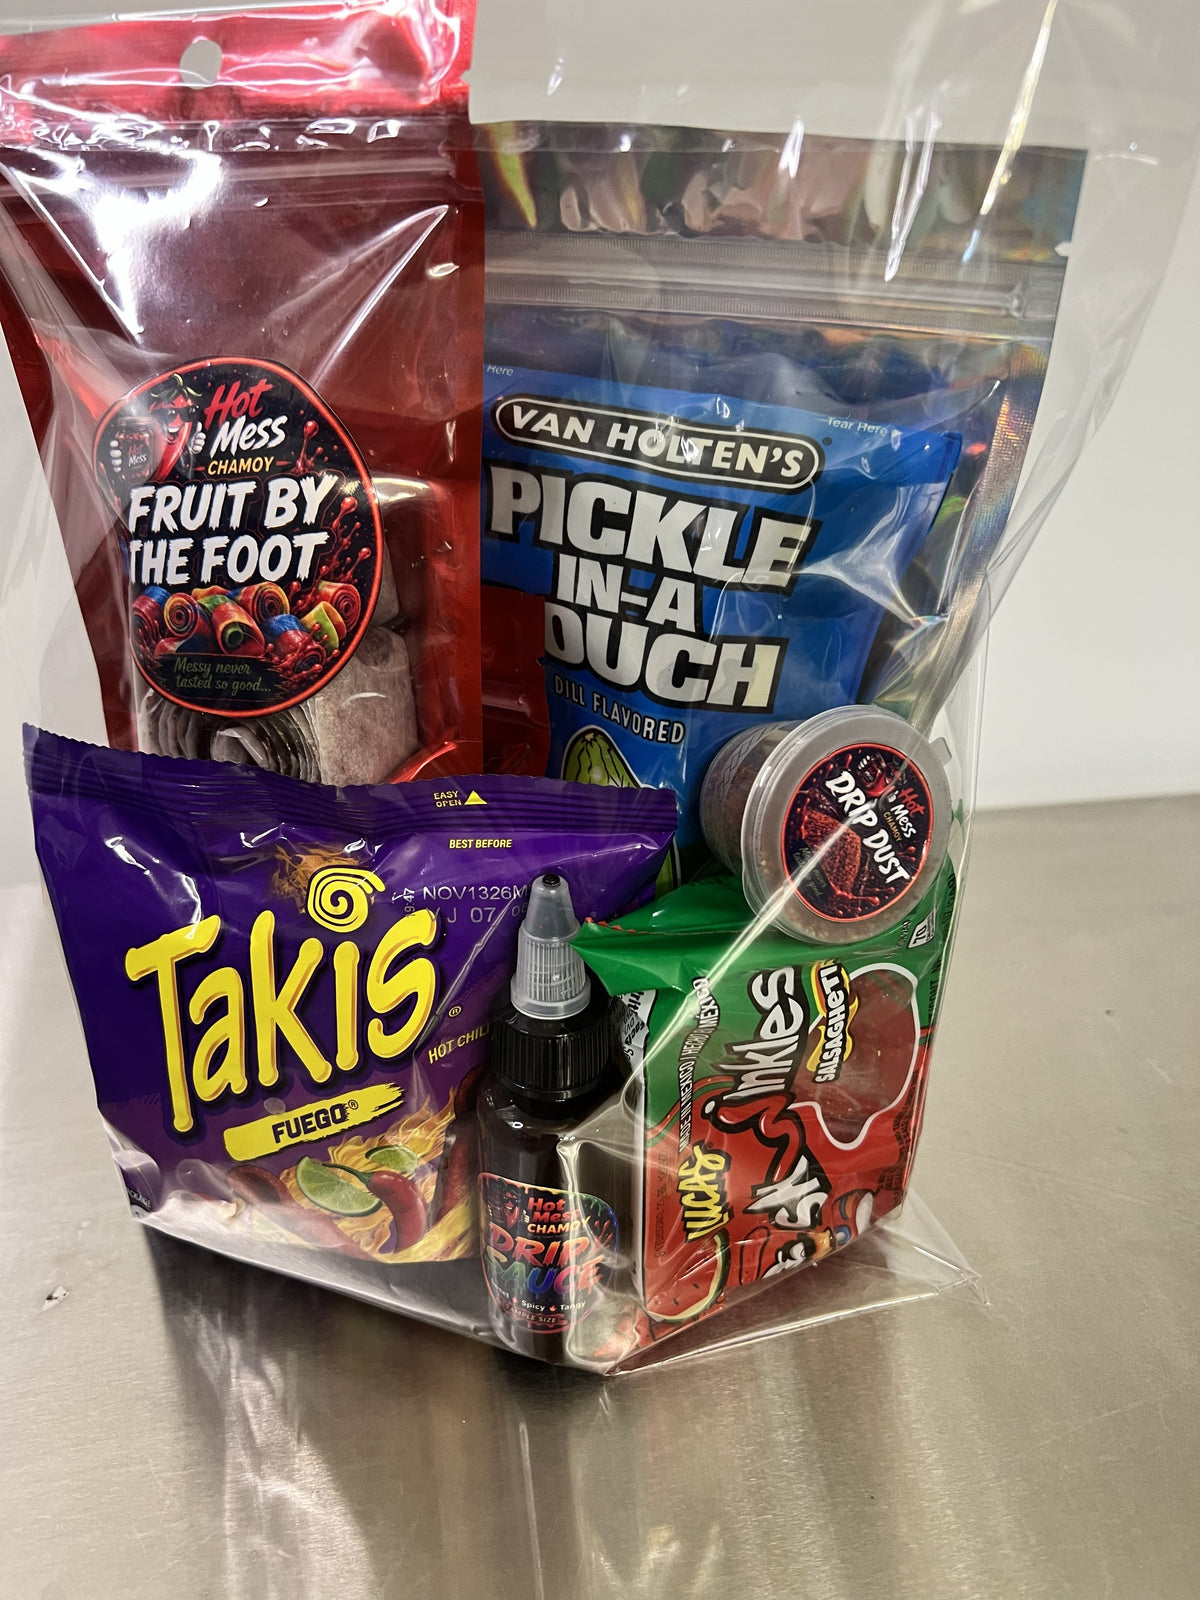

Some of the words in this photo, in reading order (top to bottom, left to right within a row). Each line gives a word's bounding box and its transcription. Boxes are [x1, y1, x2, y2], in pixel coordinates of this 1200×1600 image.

[486, 364, 514, 376] Here
[204, 379, 274, 431] Hot
[209, 415, 289, 458] Mess
[510, 404, 596, 443] VAN
[605, 422, 804, 477] HOLTEN'S
[827, 416, 854, 430] Tear
[856, 421, 889, 437] Here
[207, 456, 275, 476] CHAMOY
[129, 480, 258, 534] FRUIT
[263, 473, 340, 530] BY
[488, 465, 812, 588] PICKLE
[129, 537, 195, 586] THE
[199, 531, 330, 584] FOOT
[556, 556, 697, 632] IN-A
[173, 656, 212, 679] Messy
[215, 661, 252, 676] never
[544, 602, 783, 708] OUCH
[175, 675, 214, 690] tasted
[216, 678, 230, 691] so
[554, 676, 586, 707] DILL
[592, 690, 687, 745] FLAVORED
[433, 790, 459, 800] EASY
[435, 799, 462, 808] OPEN
[898, 787, 926, 819] Hot
[824, 770, 878, 828] DRIP
[862, 830, 911, 884] DUST
[883, 811, 903, 842] CHAMOY
[890, 803, 918, 839] Mess
[449, 839, 474, 849] BEST
[475, 839, 513, 849] BEFORE
[470, 907, 496, 923] 07
[124, 866, 438, 1134] Takis
[428, 1039, 455, 1064] HOT
[682, 1032, 709, 1055] HECHO
[680, 1060, 694, 1105] MEXICO
[681, 1105, 690, 1118] IN
[678, 1120, 692, 1152] MADE
[527, 1197, 566, 1212] Hot
[680, 1145, 729, 1240] LUCAS
[527, 1215, 592, 1235] CHAMOY
[488, 1222, 590, 1268] DRIP
[521, 1299, 546, 1312] Spicy
[560, 1300, 587, 1312] Tangy
[538, 1314, 558, 1324] SIZE
